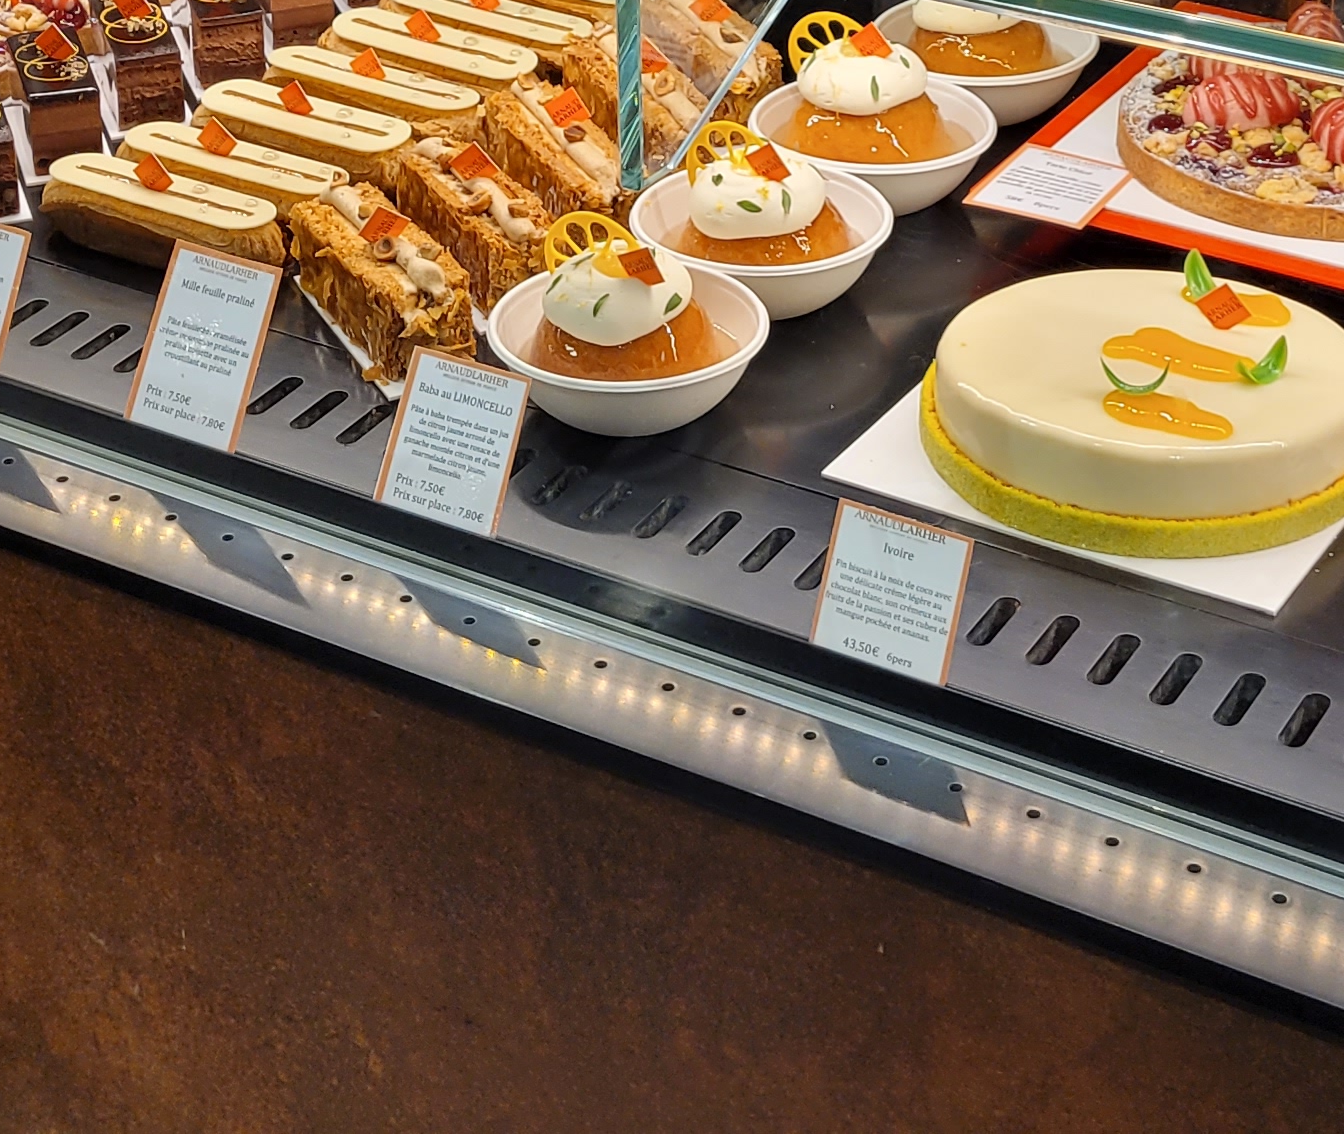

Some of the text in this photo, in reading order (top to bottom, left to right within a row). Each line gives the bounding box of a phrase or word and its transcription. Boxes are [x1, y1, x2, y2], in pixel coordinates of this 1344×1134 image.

[181, 278, 255, 308] Mille feuille praliné
[419, 382, 513, 417] Baba au LIMONCELLO
[855, 509, 946, 544] ARNAUDLARHER
[883, 542, 915, 561] Ivoire
[843, 636, 912, 668] 43,50€ 6pers
